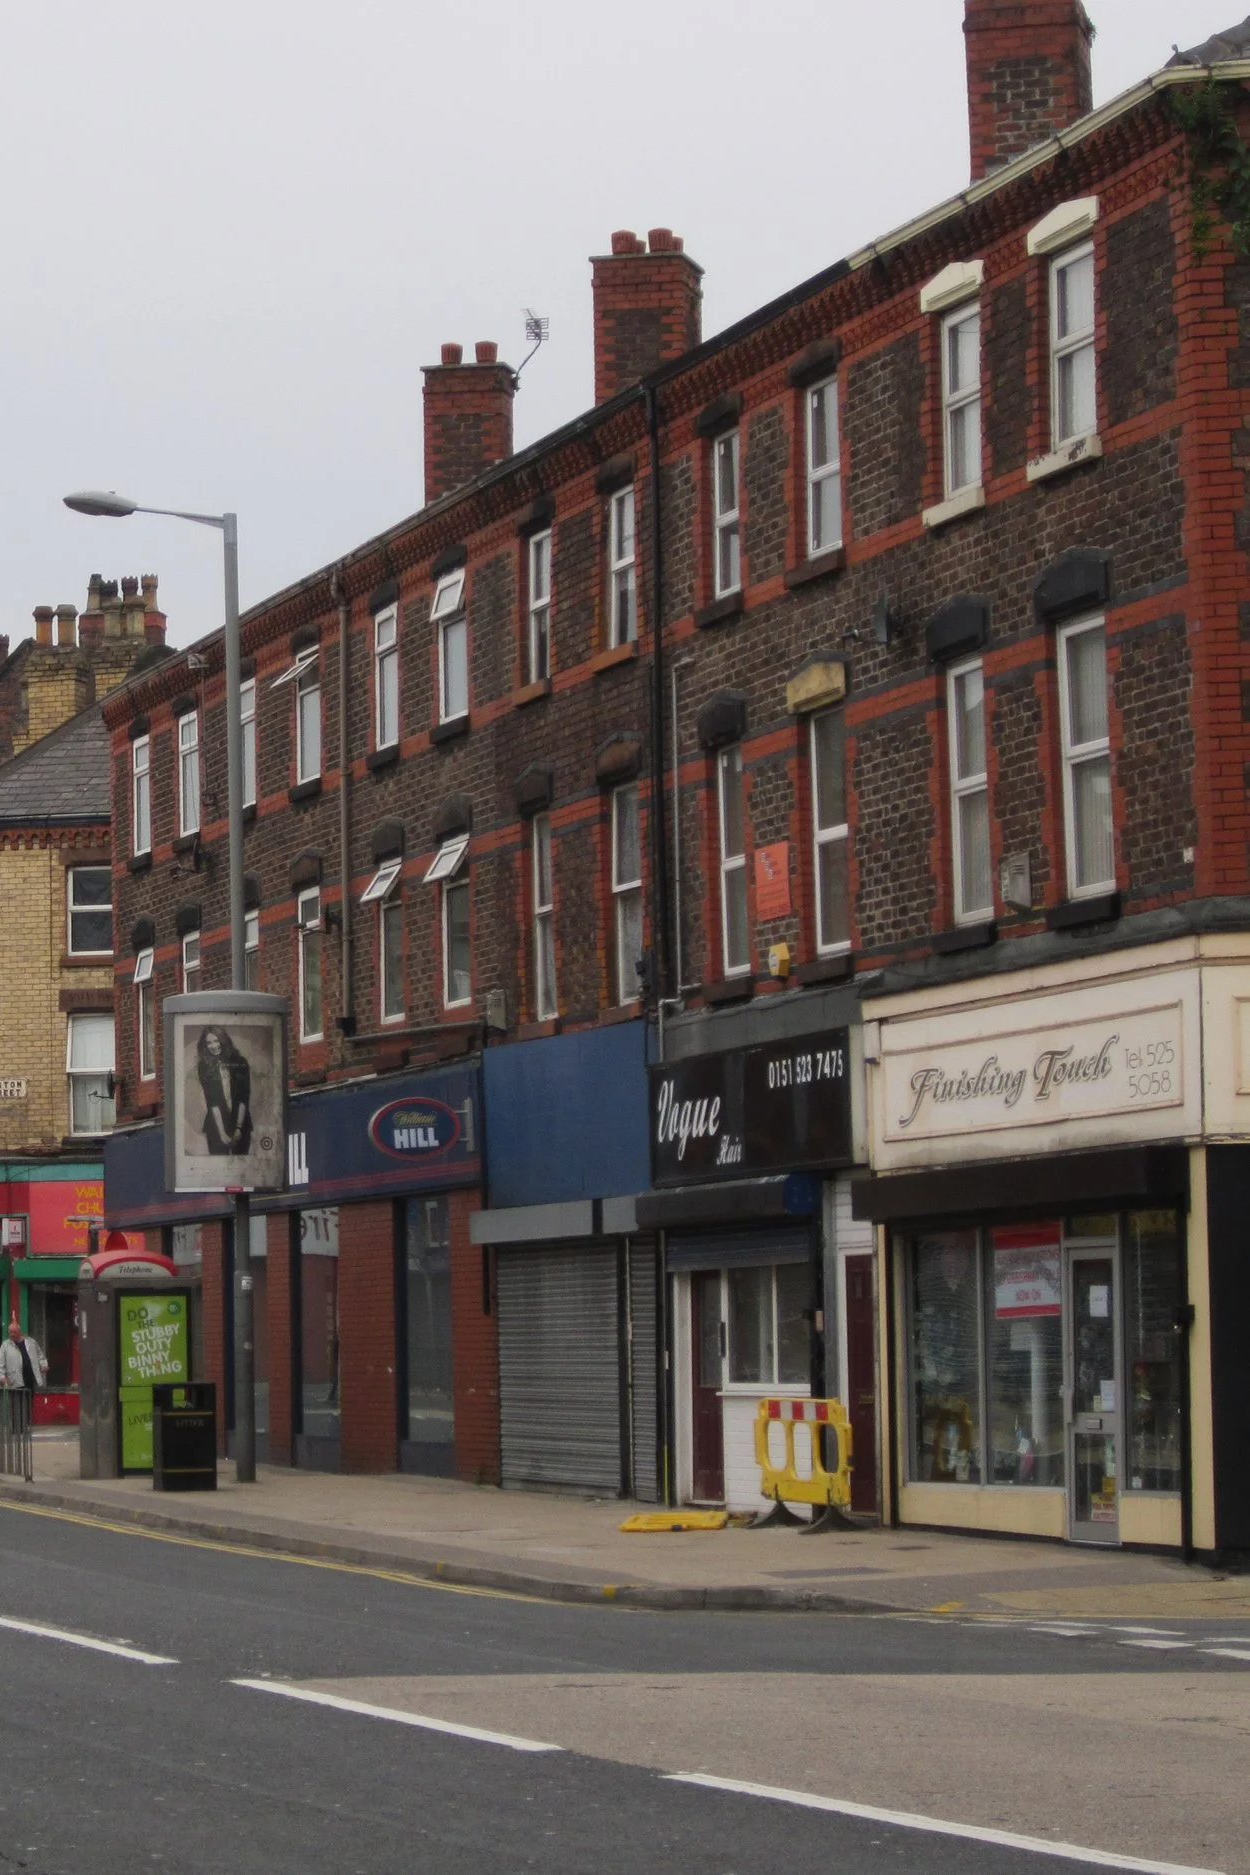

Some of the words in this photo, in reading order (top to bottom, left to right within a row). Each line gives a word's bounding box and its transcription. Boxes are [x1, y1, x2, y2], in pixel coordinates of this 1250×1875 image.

[1147, 1040, 1175, 1067] 525
[768, 1058, 793, 1089] 0151
[796, 1054, 813, 1084] 523
[817, 1049, 844, 1081] 7475
[899, 1055, 1027, 1127] Finishing
[1033, 1032, 1121, 1101] Touch
[1128, 1070, 1172, 1099] 5058
[658, 1080, 721, 1161] Vogue
[393, 1127, 440, 1149] HILL
[716, 1135, 743, 1166] Hair
[288, 1132, 309, 1186] ILL
[119, 1265, 153, 1275] Telephone
[127, 1307, 149, 1322] DO
[131, 1324, 180, 1343] STUBBY
[135, 1336, 172, 1354] OUTY
[127, 1351, 171, 1369] BINNY
